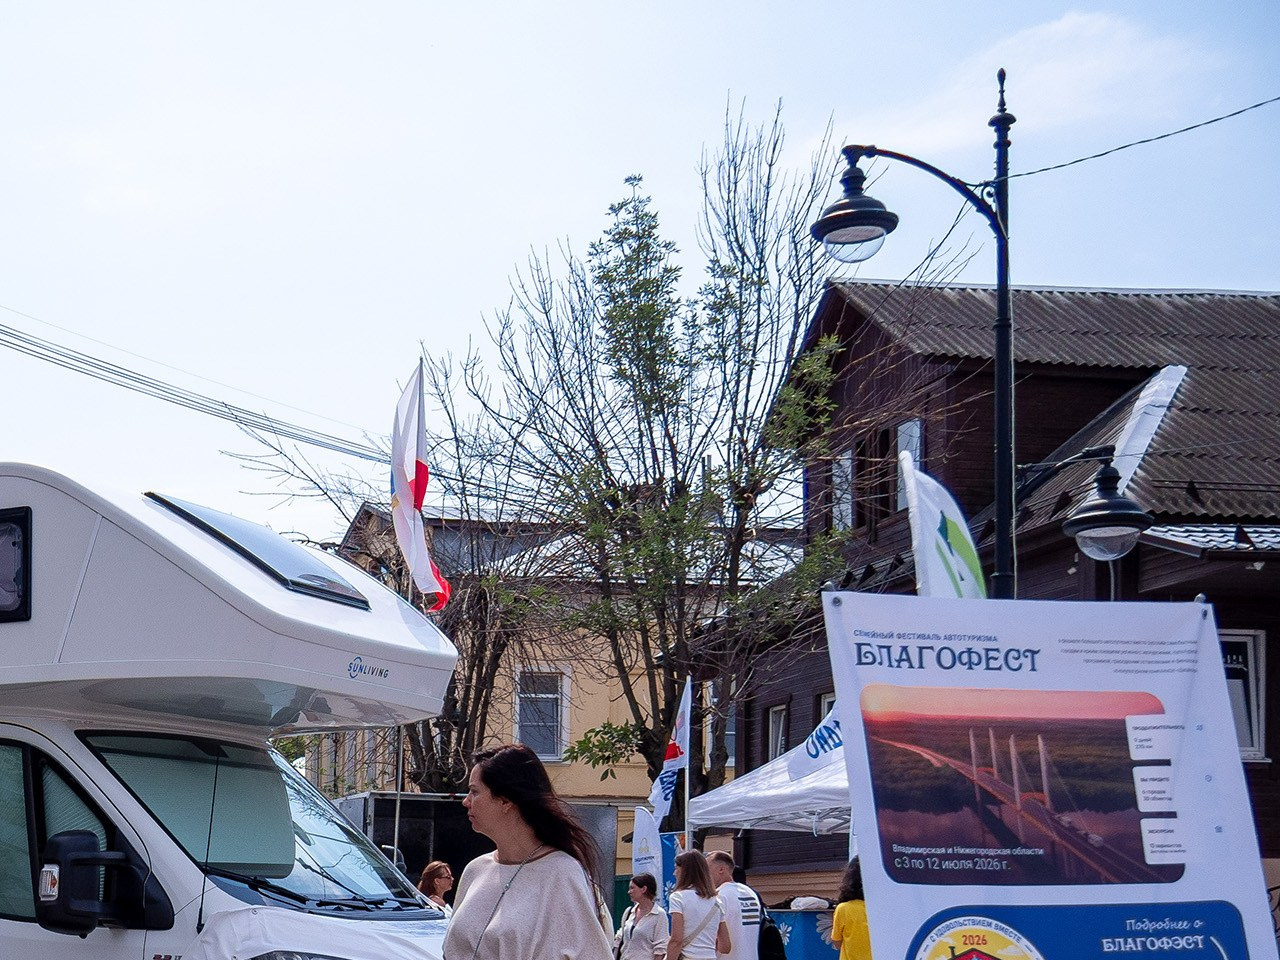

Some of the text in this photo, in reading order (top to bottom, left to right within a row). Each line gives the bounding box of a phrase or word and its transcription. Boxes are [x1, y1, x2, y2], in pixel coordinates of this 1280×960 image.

[853, 629, 998, 642] СЕМЕЙНЫЙ ФЕСТИВАЛЬ АВТОТУРИЗМА
[854, 642, 1041, 672] БЛАГОФЕСТ
[348, 662, 389, 678] SUNLIVING
[892, 844, 946, 854] Владимирская
[954, 846, 1011, 856] Нижегородская
[1012, 847, 1044, 855] области
[894, 856, 1011, 870] с 3 по 12 июля 2026 г.
[936, 918, 992, 939] УДОВОЛЬСТВИЕМ
[993, 923, 1022, 944] ВМЕСТЕ
[1126, 918, 1203, 932] Подробнее о
[962, 934, 988, 946] 2026
[1102, 935, 1204, 952] БЛАГОФЭСТ
